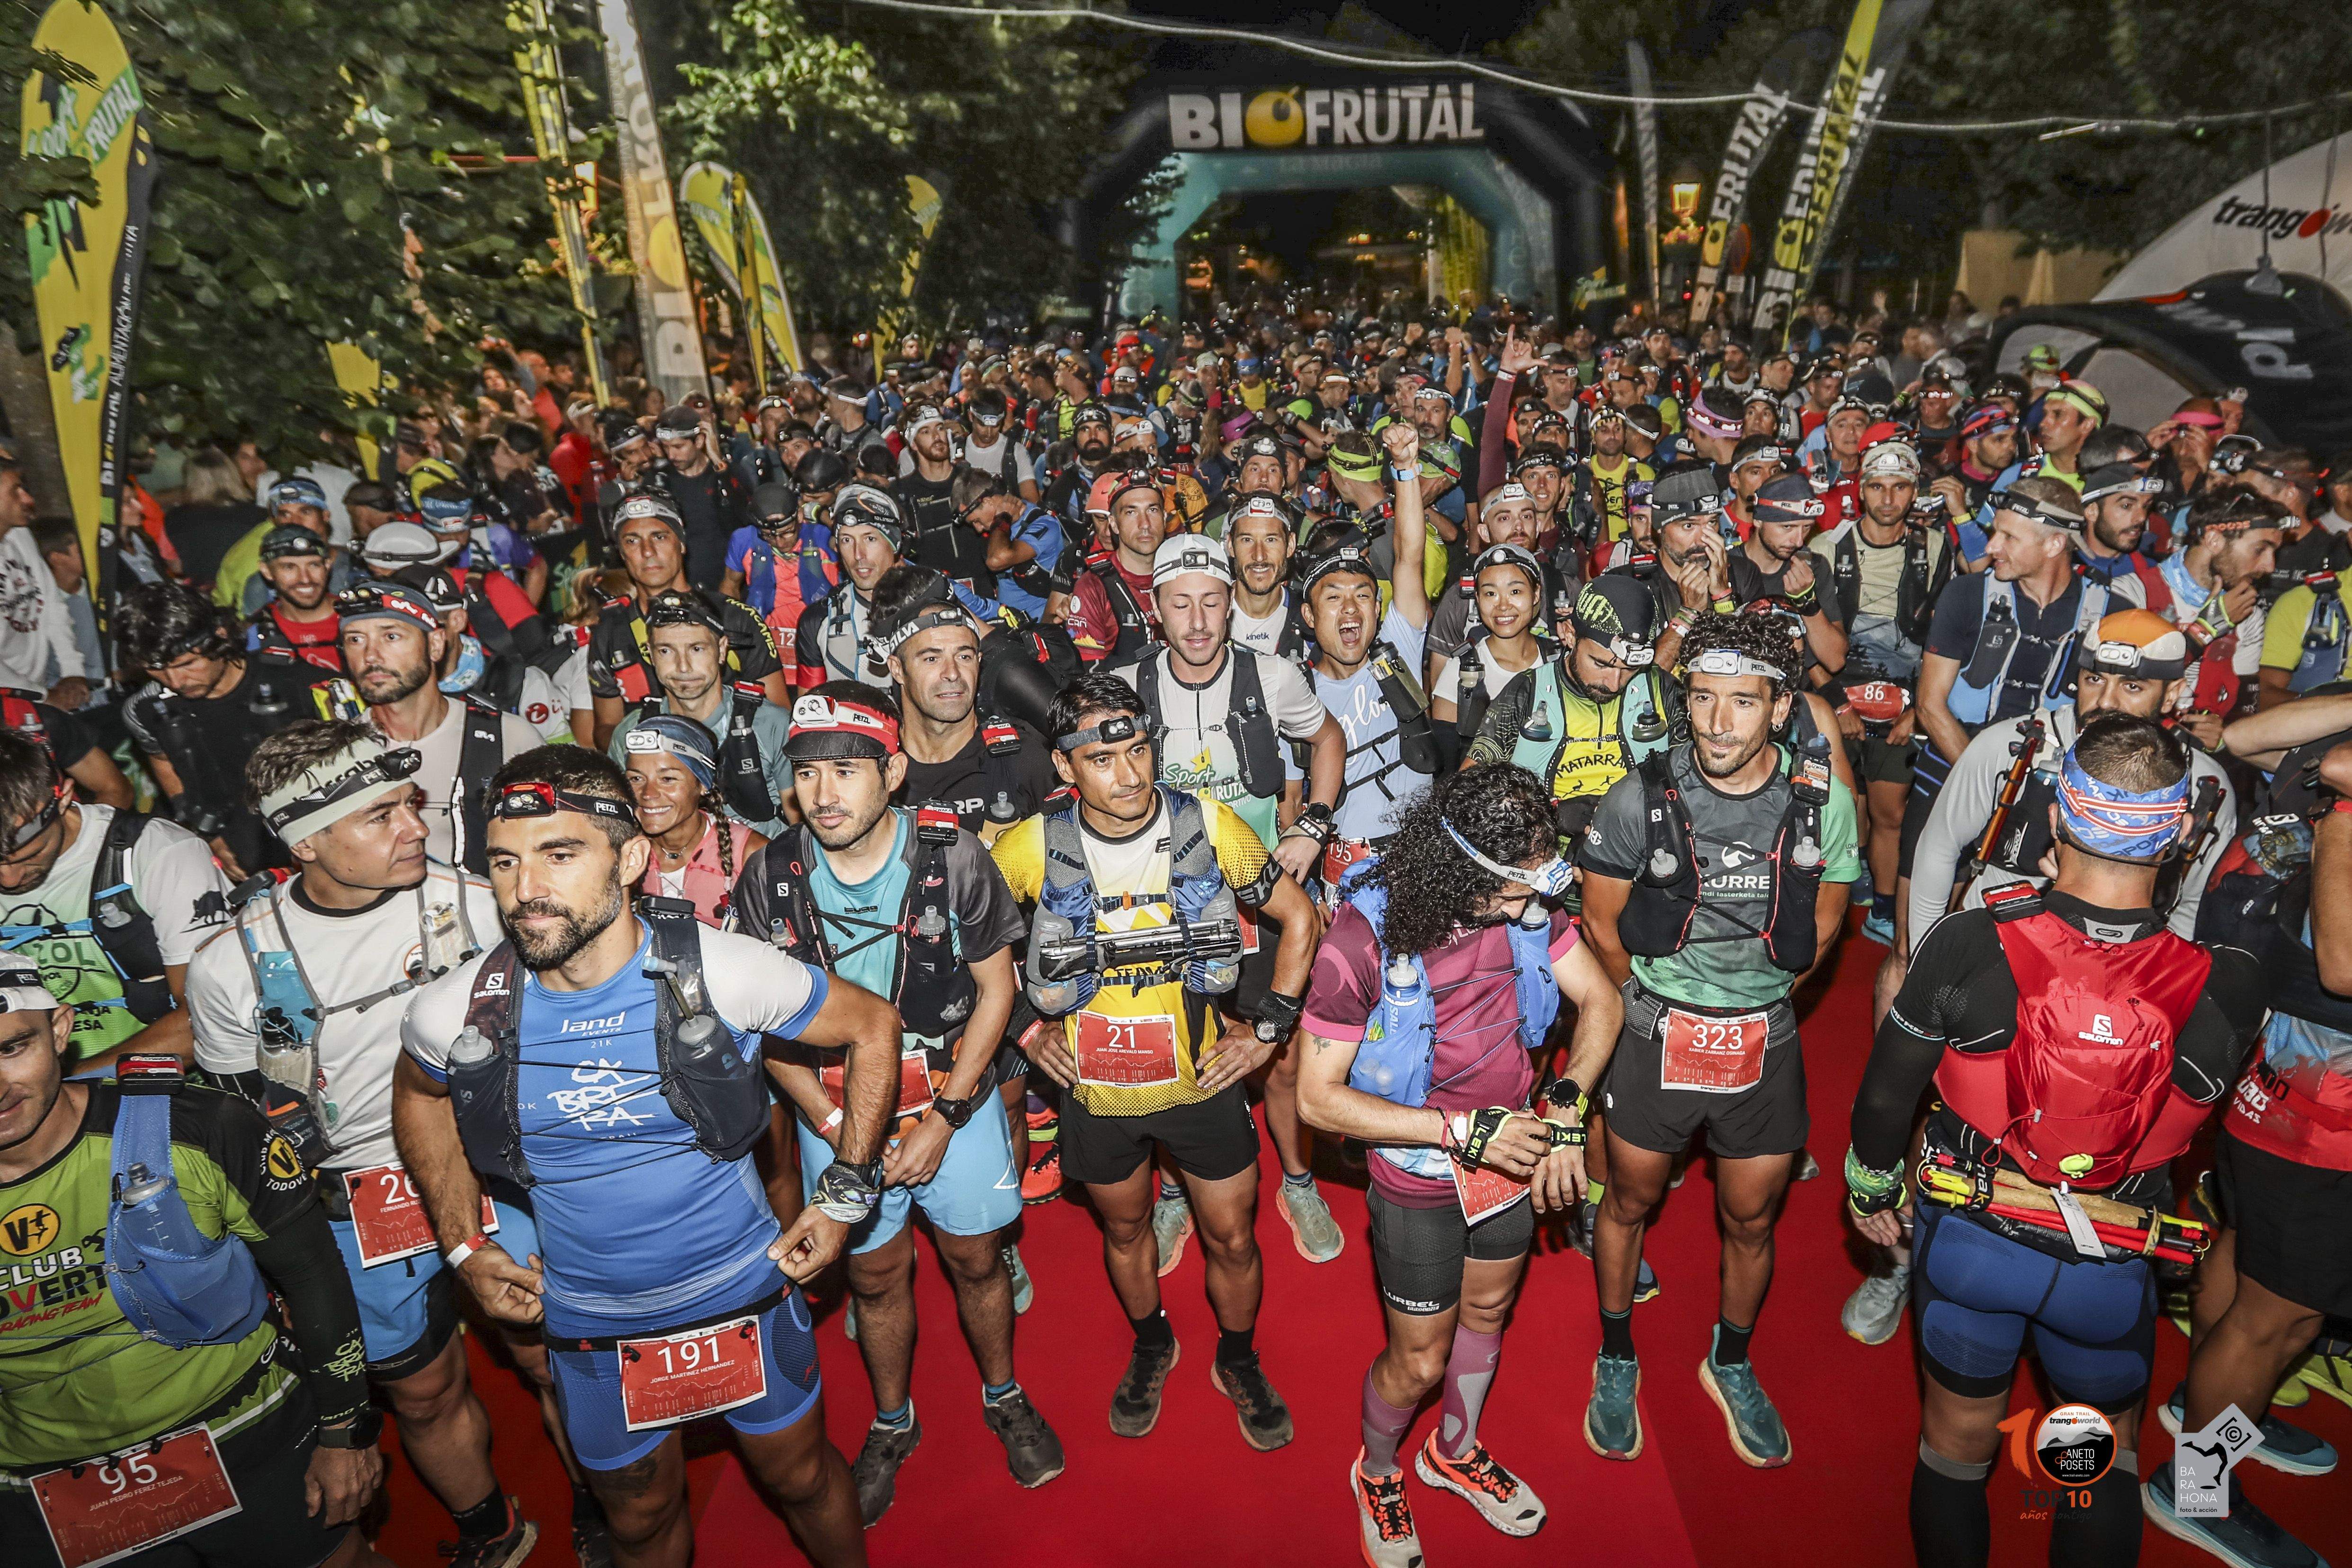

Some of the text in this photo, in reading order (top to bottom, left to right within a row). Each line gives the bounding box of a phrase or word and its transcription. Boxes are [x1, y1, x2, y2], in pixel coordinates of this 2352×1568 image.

[1168, 81, 1485, 149] BIOFRUTAL
[109, 297, 134, 386] ALIMENTACIÓN
[2012, 503, 2029, 514] PETZL
[888, 621, 920, 654] SILVA
[1246, 632, 1270, 641] kinetik
[1752, 663, 1766, 672] PETZL
[1864, 685, 1885, 700] 86
[853, 713, 870, 724] PETZL
[673, 743, 687, 752] PETZL
[362, 768, 382, 785] PET
[1165, 763, 1216, 787] Sport
[596, 802, 618, 813] PETZL
[1299, 819, 1323, 839] LEKI
[1507, 871, 1527, 880] PETZL
[474, 989, 510, 999] salomon
[560, 1011, 626, 1034] land
[581, 1027, 622, 1037] EVENTS
[1107, 1024, 1135, 1049] 21
[1692, 1024, 1743, 1050] 323
[2078, 1031, 2124, 1046] salomon
[2234, 1096, 2261, 1124] VIDAS
[1467, 1127, 1487, 1159] LEKI
[1556, 1131, 1586, 1143] LEKI
[380, 1202, 410, 1214] FERNANDO
[1383, 1286, 1440, 1308] LURBEL
[657, 1335, 722, 1374] 191
[650, 1360, 735, 1384] JORGE MARTINEZ HERNANDEZ
[99, 1452, 158, 1495] 95
[89, 1501, 108, 1511] JUAN
[109, 1492, 134, 1503] PEDRO
[155, 1475, 184, 1488] TEJEDA
